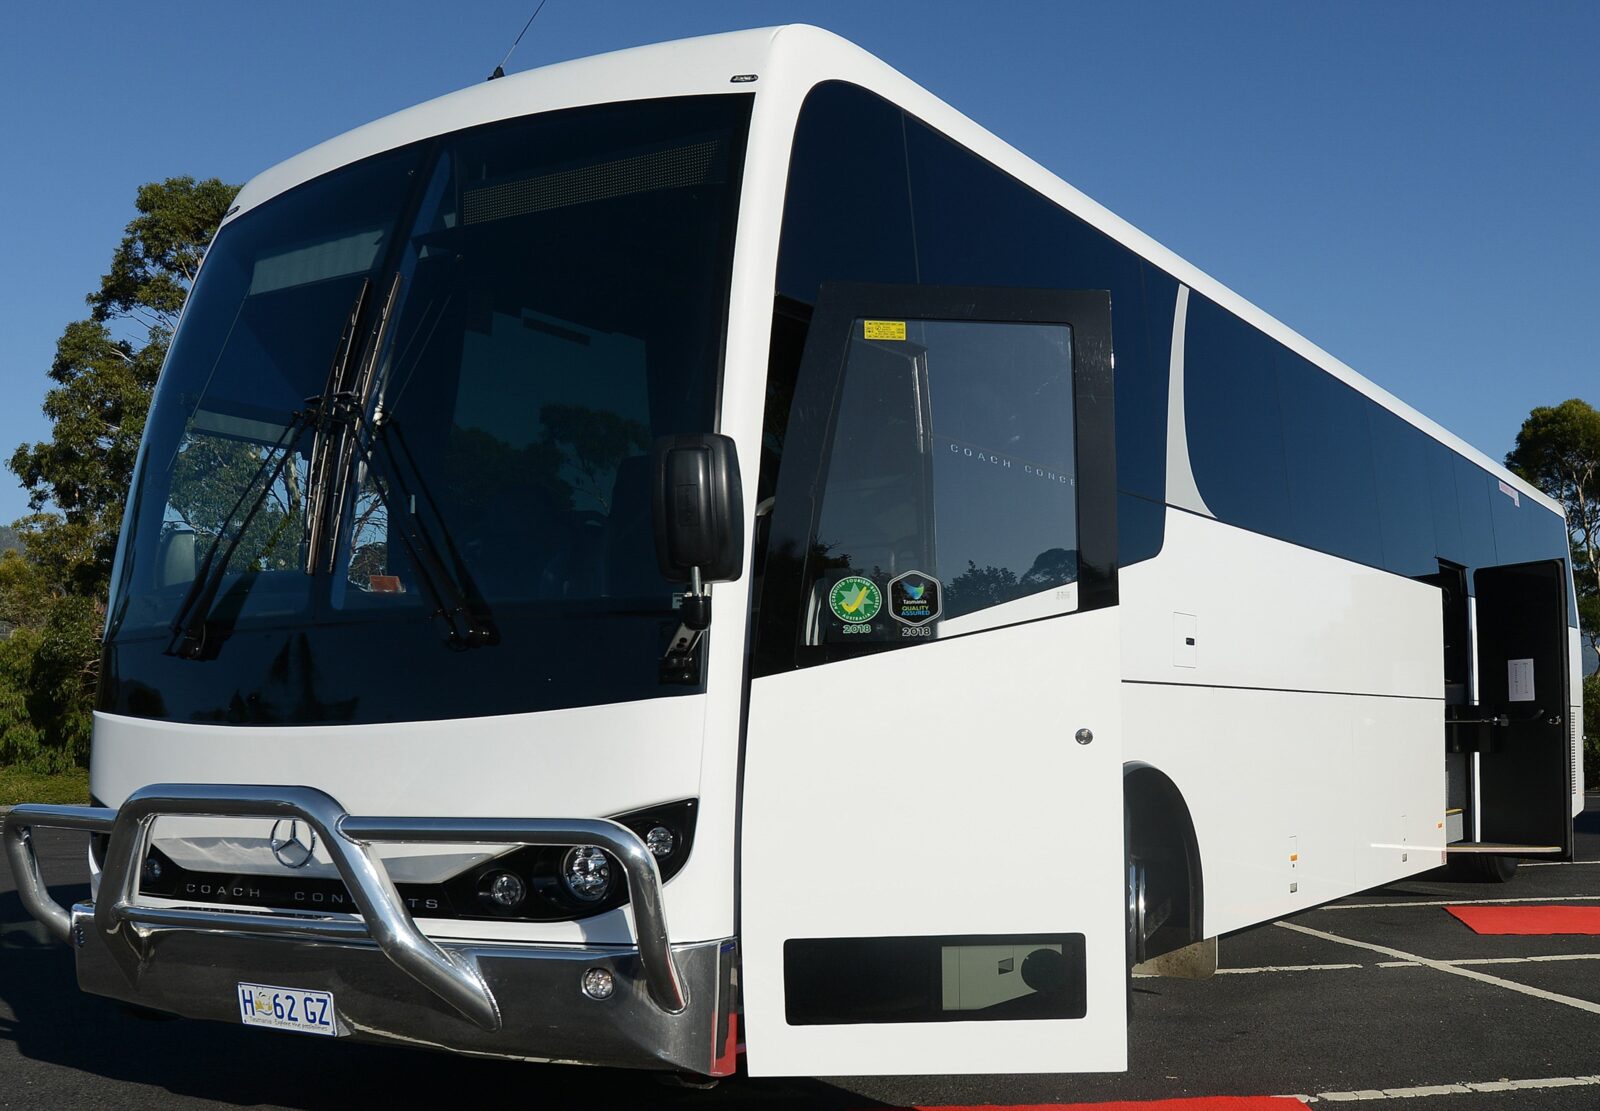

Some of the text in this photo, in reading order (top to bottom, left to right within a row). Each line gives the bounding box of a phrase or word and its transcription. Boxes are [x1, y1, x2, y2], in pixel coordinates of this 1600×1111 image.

[950, 443, 1011, 468] COACH
[846, 578, 871, 587] TOURISM
[842, 613, 871, 621] AUSTRALIA
[843, 624, 872, 634] 2018
[902, 626, 931, 637] 2018
[186, 883, 438, 909] COACH CONTS
[242, 989, 330, 1026] H 62 GZ
